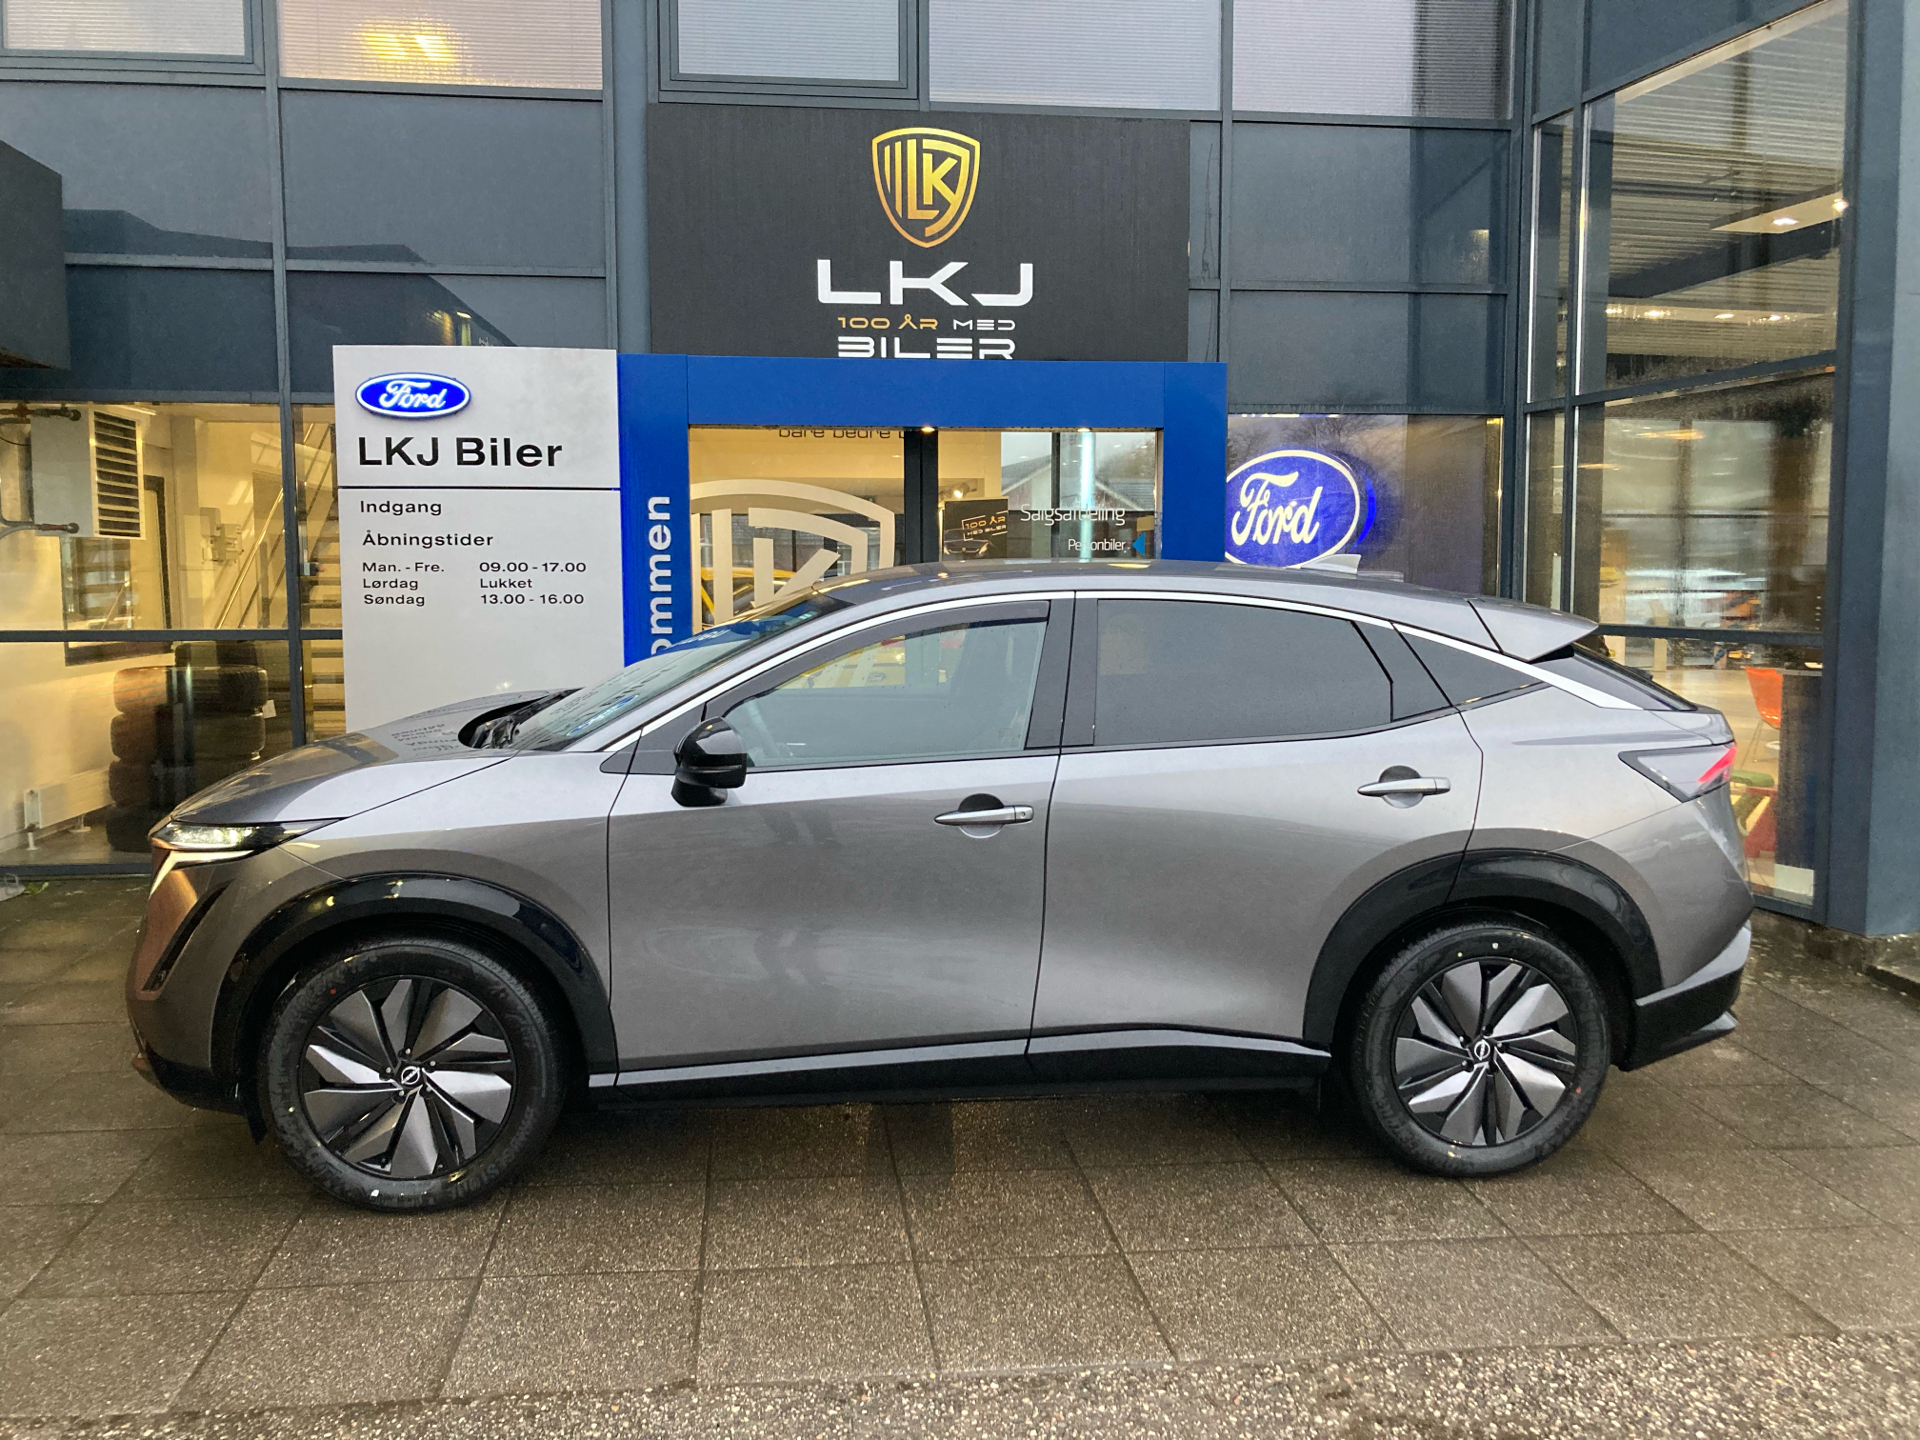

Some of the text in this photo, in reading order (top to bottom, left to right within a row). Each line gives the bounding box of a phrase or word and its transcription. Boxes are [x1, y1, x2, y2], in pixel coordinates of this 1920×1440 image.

[817, 259, 1033, 307] LKJ
[837, 313, 1016, 331] 100 ÅR MED
[837, 336, 1016, 360] BILER
[379, 379, 446, 409] Ford
[358, 436, 563, 468] LKJ Biler
[360, 500, 442, 516] Indgang
[1020, 503, 1126, 526] Salgsaeling
[1231, 470, 1324, 546] Ford
[965, 520, 987, 530] 100
[362, 529, 494, 550] Åbningstider
[1068, 537, 1126, 551] Peonbiler
[362, 561, 402, 573] Man.
[414, 561, 445, 573] Fre.
[479, 561, 529, 573] 09.00
[541, 561, 587, 573] 17.00
[362, 578, 533, 591] Lørdag Lukket
[363, 593, 425, 608] Søndag
[480, 593, 526, 605] 13.00
[539, 593, 585, 605] 16.00
